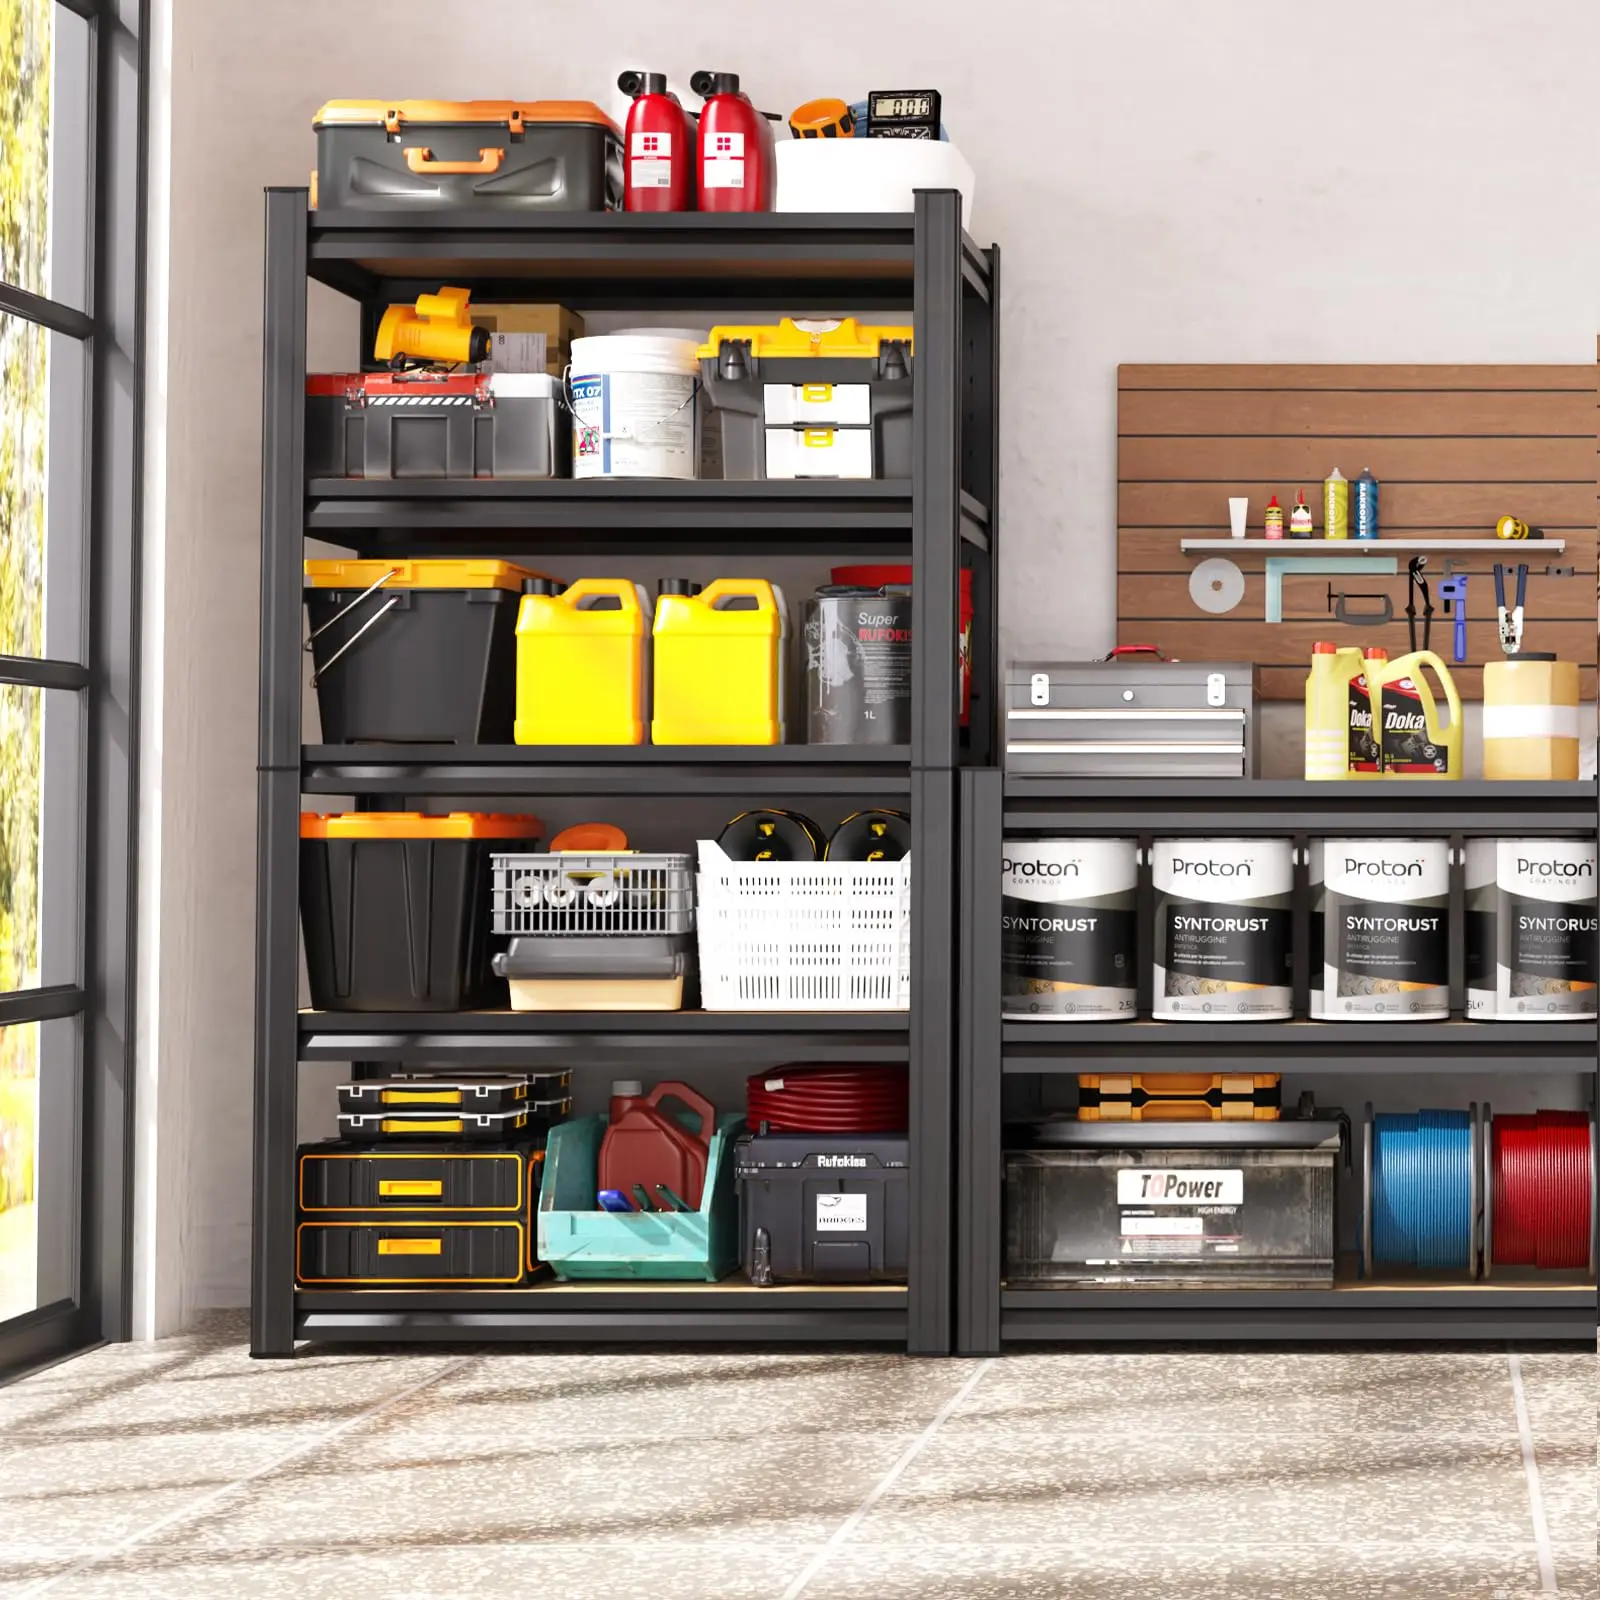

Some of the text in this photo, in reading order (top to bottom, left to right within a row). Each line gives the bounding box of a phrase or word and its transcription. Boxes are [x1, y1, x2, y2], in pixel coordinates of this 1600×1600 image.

[858, 612, 898, 627] Super
[864, 711, 876, 719] 1L
[1350, 709, 1372, 727] Doka
[1385, 712, 1424, 729] Doka
[1002, 858, 1082, 876] Proton
[1172, 858, 1253, 876] Proton
[1345, 858, 1425, 876] Proton
[1517, 858, 1594, 876] Proton
[1002, 916, 1097, 931] SYNTORUST
[1174, 916, 1269, 931] SYNTORUST
[1346, 916, 1439, 931] SYNTORUST
[1141, 1174, 1223, 1198] TOPower
